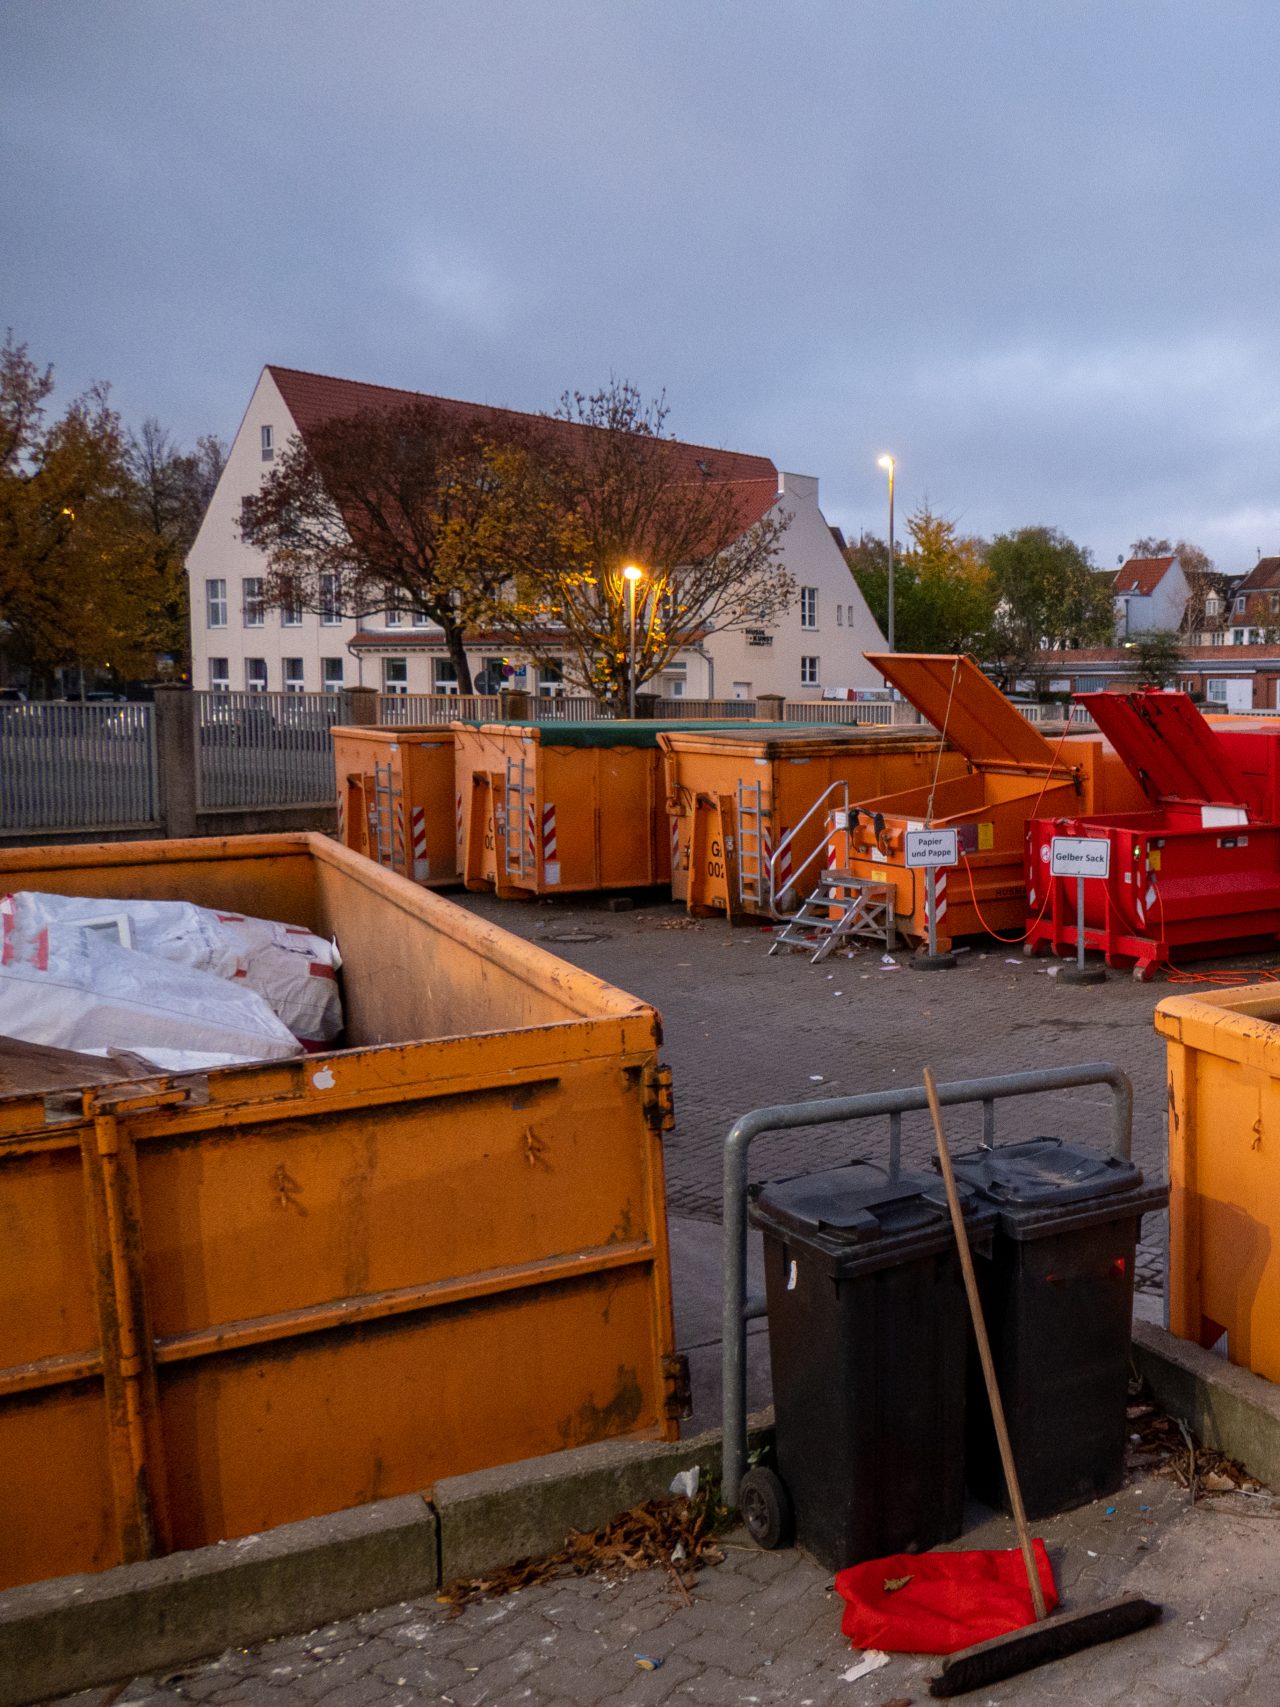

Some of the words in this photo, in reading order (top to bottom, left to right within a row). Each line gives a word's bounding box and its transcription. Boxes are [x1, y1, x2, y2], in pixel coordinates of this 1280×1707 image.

[918, 838, 943, 847] Papier
[911, 849, 926, 858] und
[928, 849, 952, 859] Pappe
[1055, 852, 1083, 862] Gelber
[1085, 853, 1105, 863] Sack
